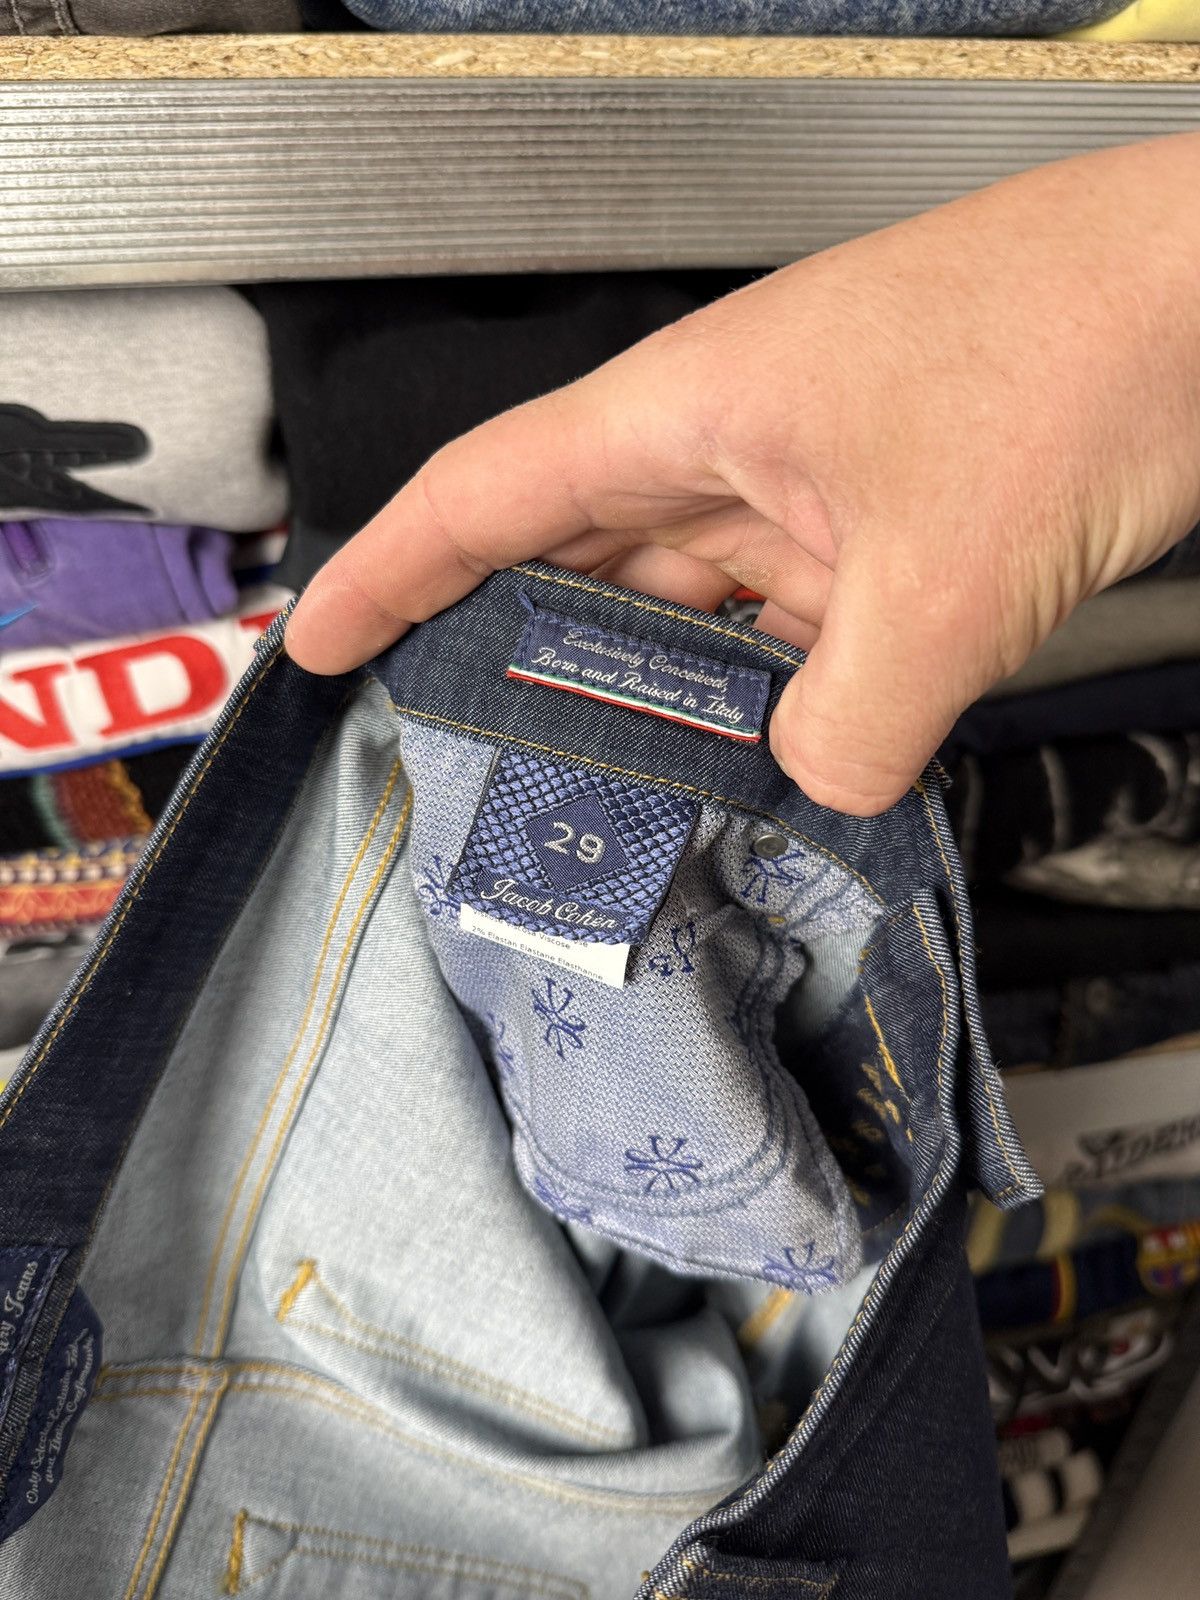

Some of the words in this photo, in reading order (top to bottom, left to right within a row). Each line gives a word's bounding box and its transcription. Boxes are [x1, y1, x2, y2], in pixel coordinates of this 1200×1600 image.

[562, 630, 646, 668] Exclusively
[648, 654, 728, 693] Conceived,
[531, 646, 580, 674] Born
[581, 664, 618, 685] and
[617, 671, 683, 700] Raised
[682, 692, 699, 708] in
[700, 694, 744, 724] Italy
[544, 820, 606, 864] 29
[480, 878, 554, 915] Jacob
[472, 925, 486, 936] 2%
[488, 931, 518, 947] Elastan
[520, 943, 556, 961] Elastane
[539, 932, 571, 949] Viscose
[4, 1260, 38, 1318] Jeans
[26, 1470, 42, 1504] Only
